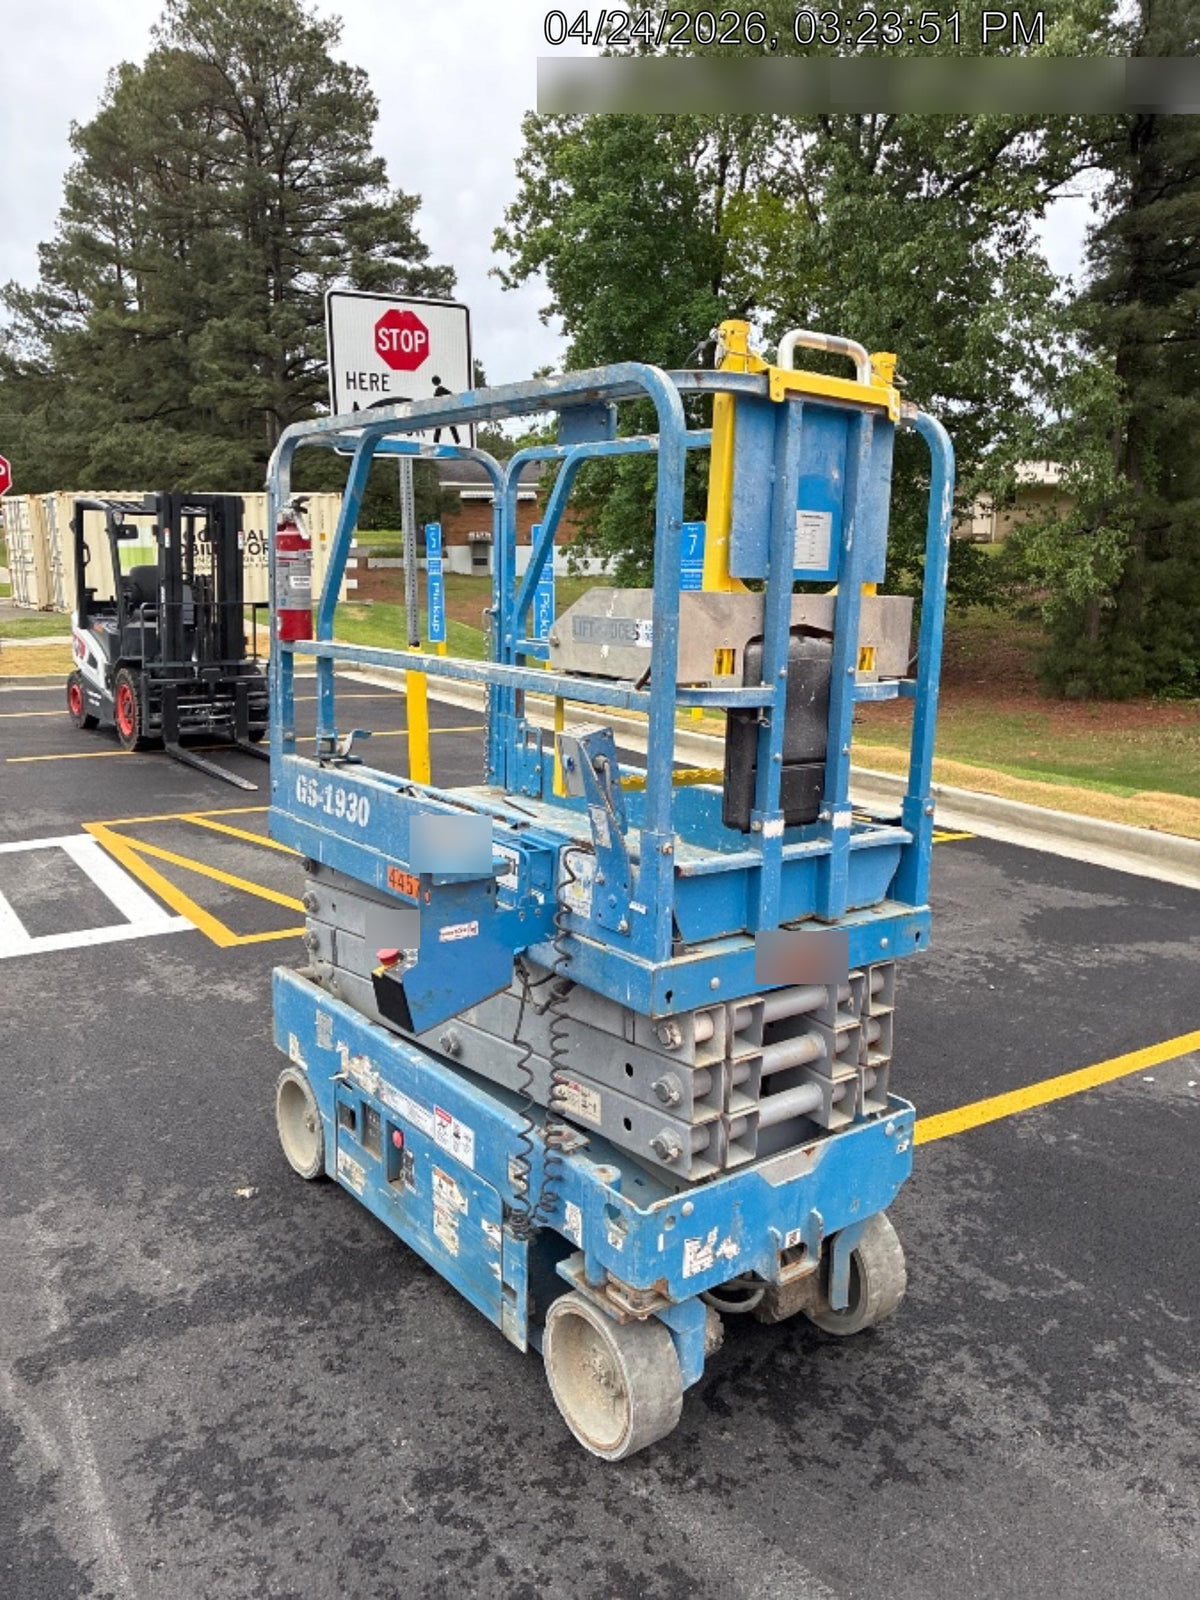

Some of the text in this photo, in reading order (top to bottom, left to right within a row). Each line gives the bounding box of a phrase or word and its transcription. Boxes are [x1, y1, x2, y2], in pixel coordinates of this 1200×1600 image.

[377, 327, 426, 352] STOP
[346, 371, 391, 392] HERE
[688, 534, 698, 556] 7
[540, 592, 550, 640] Picku
[296, 774, 370, 828] GS-1930
